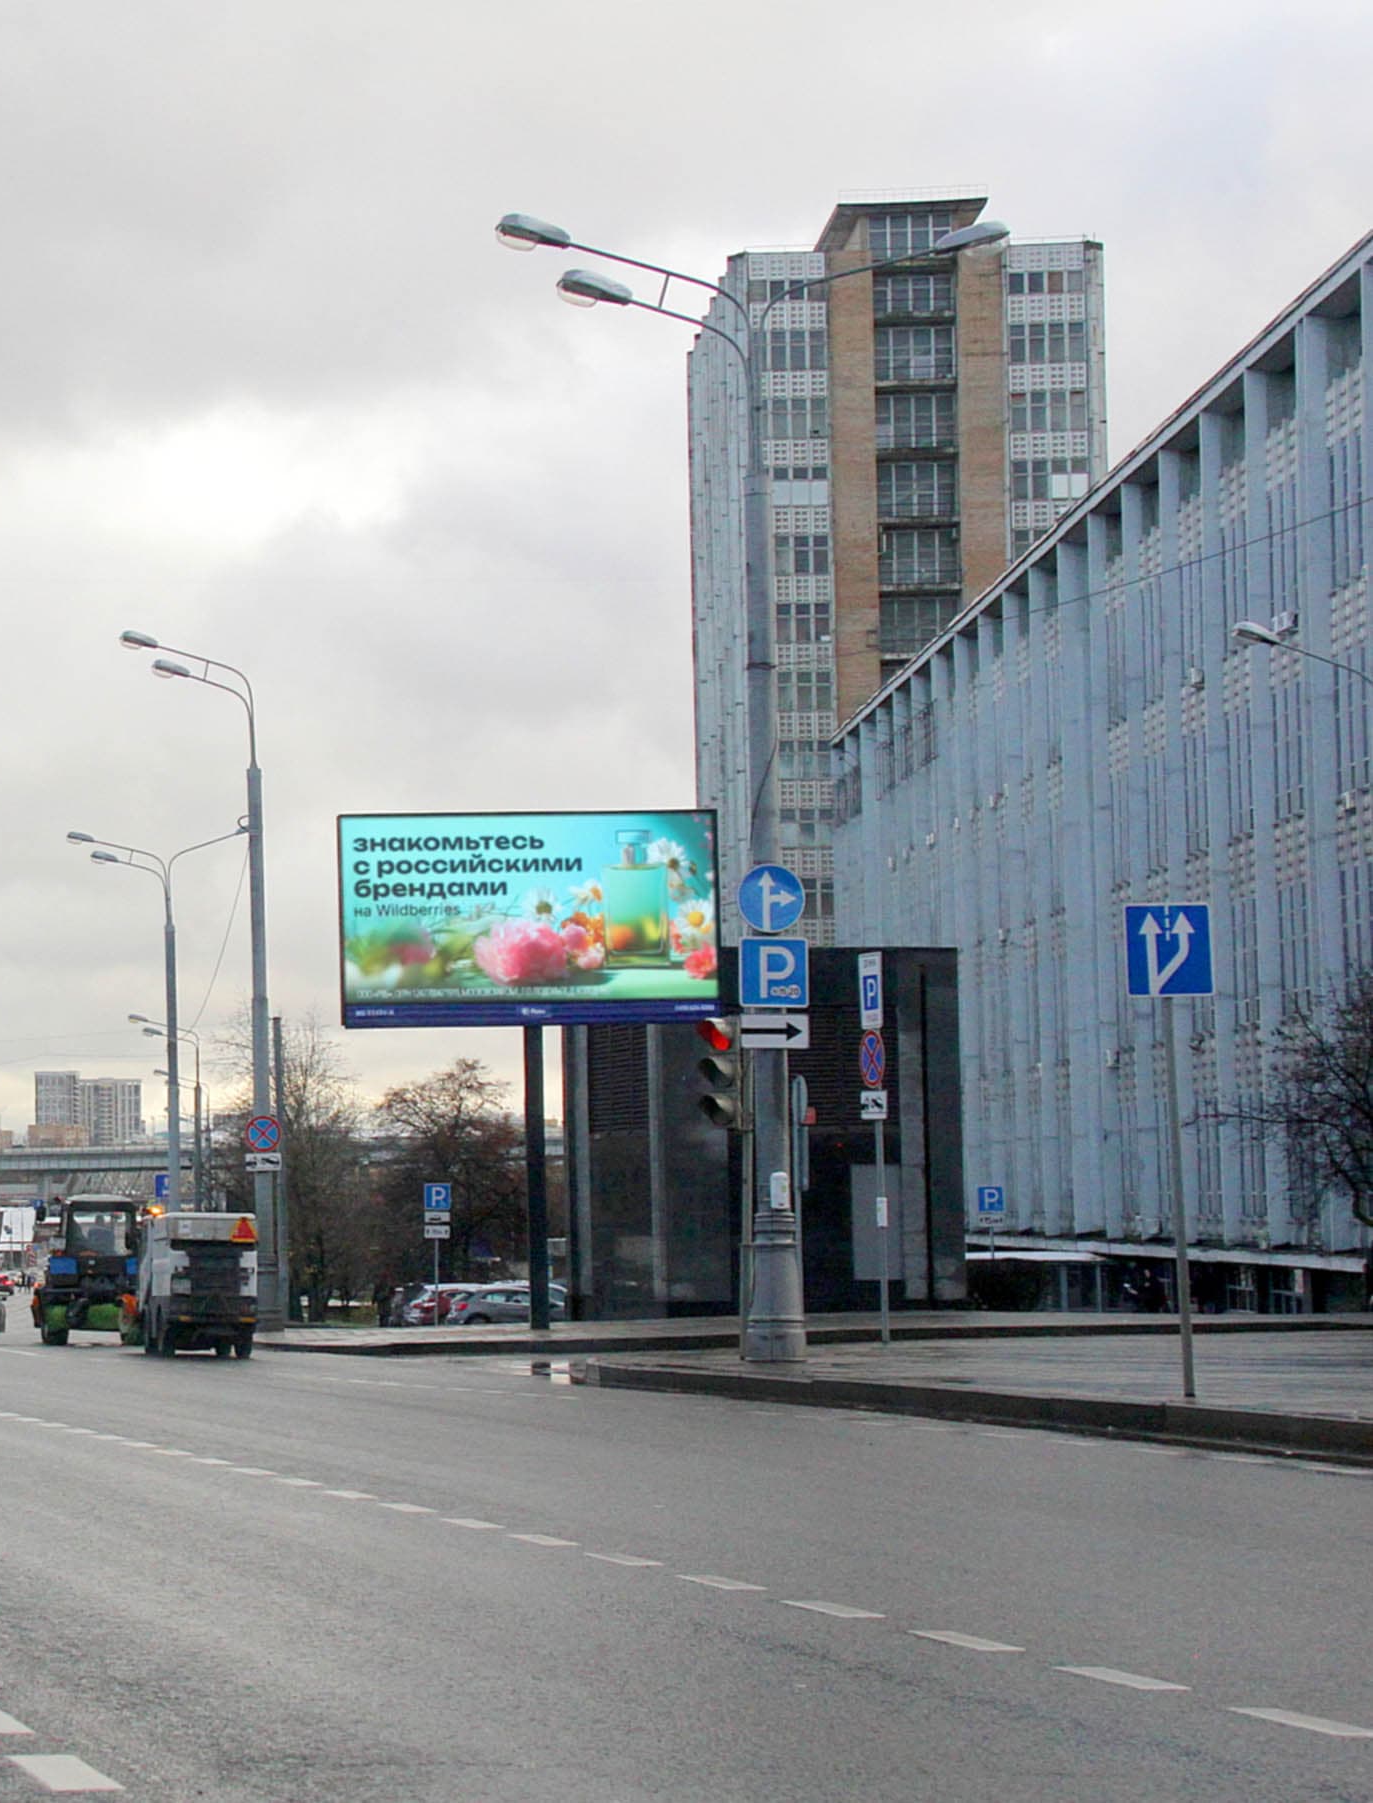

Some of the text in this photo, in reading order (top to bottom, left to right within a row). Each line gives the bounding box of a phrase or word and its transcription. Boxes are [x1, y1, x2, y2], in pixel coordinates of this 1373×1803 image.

[353, 835, 545, 852] знакомьтесь
[353, 854, 583, 878] с российскими
[353, 879, 508, 901] брендами
[354, 903, 461, 917] на Wildberries
[760, 946, 795, 998] P
[867, 978, 876, 1008] P
[431, 1187, 446, 1207] P
[984, 1189, 999, 1209] P
